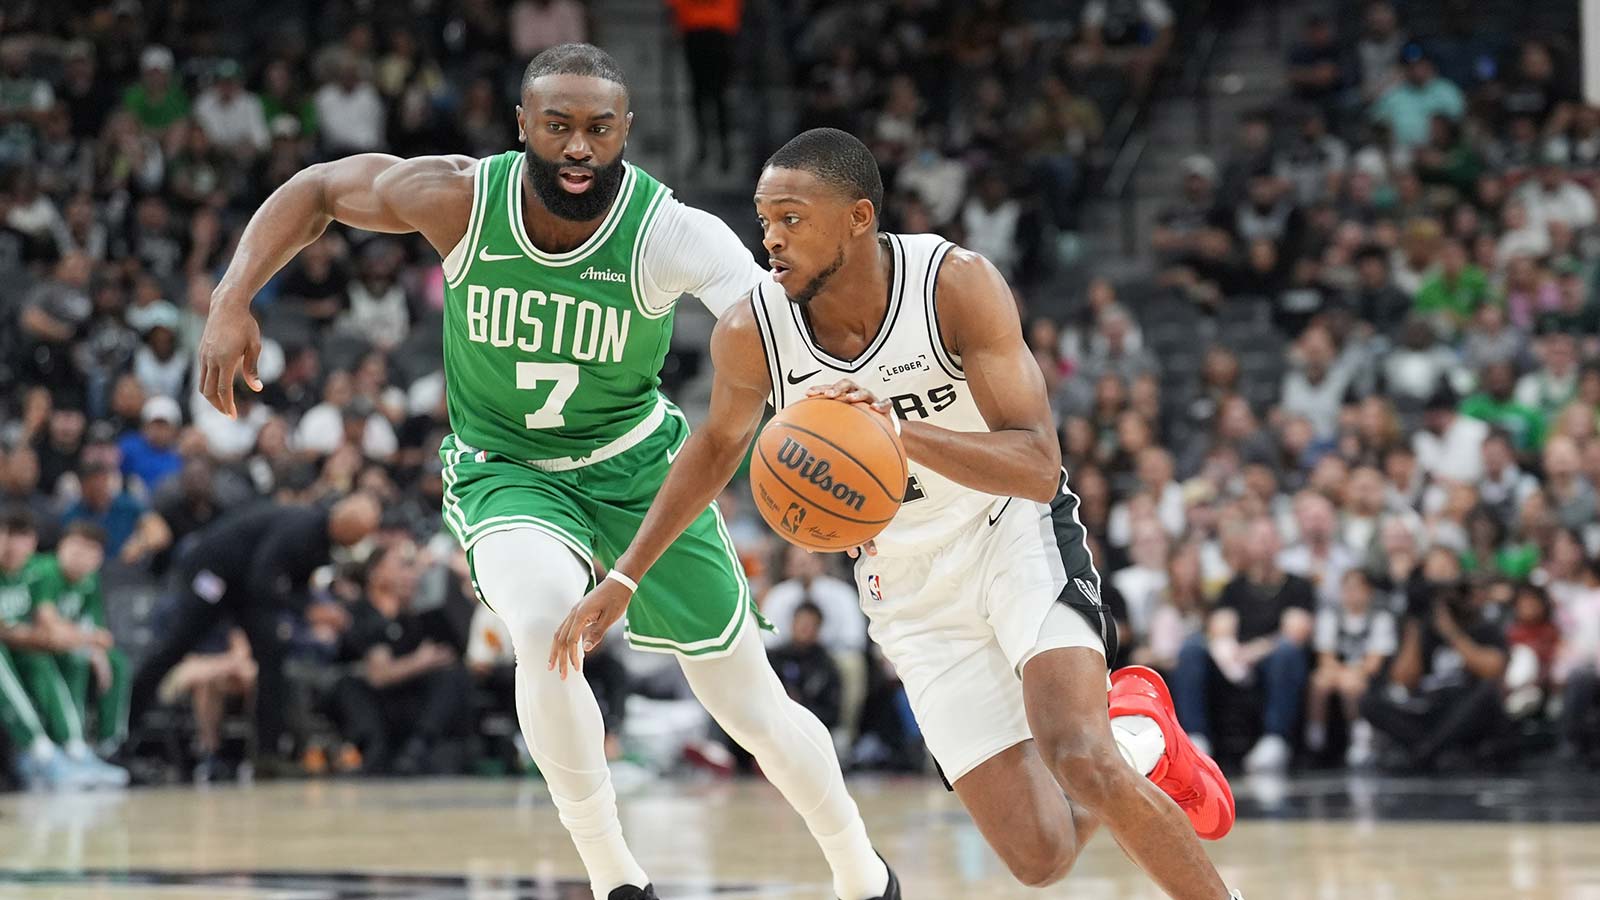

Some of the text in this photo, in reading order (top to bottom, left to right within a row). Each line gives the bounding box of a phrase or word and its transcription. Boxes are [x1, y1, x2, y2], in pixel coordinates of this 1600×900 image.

[580, 266, 626, 283] Amica
[467, 285, 631, 363] BOSTON
[516, 361, 580, 430] 7
[886, 360, 922, 376] LEDGER
[777, 436, 867, 512] Wilson
